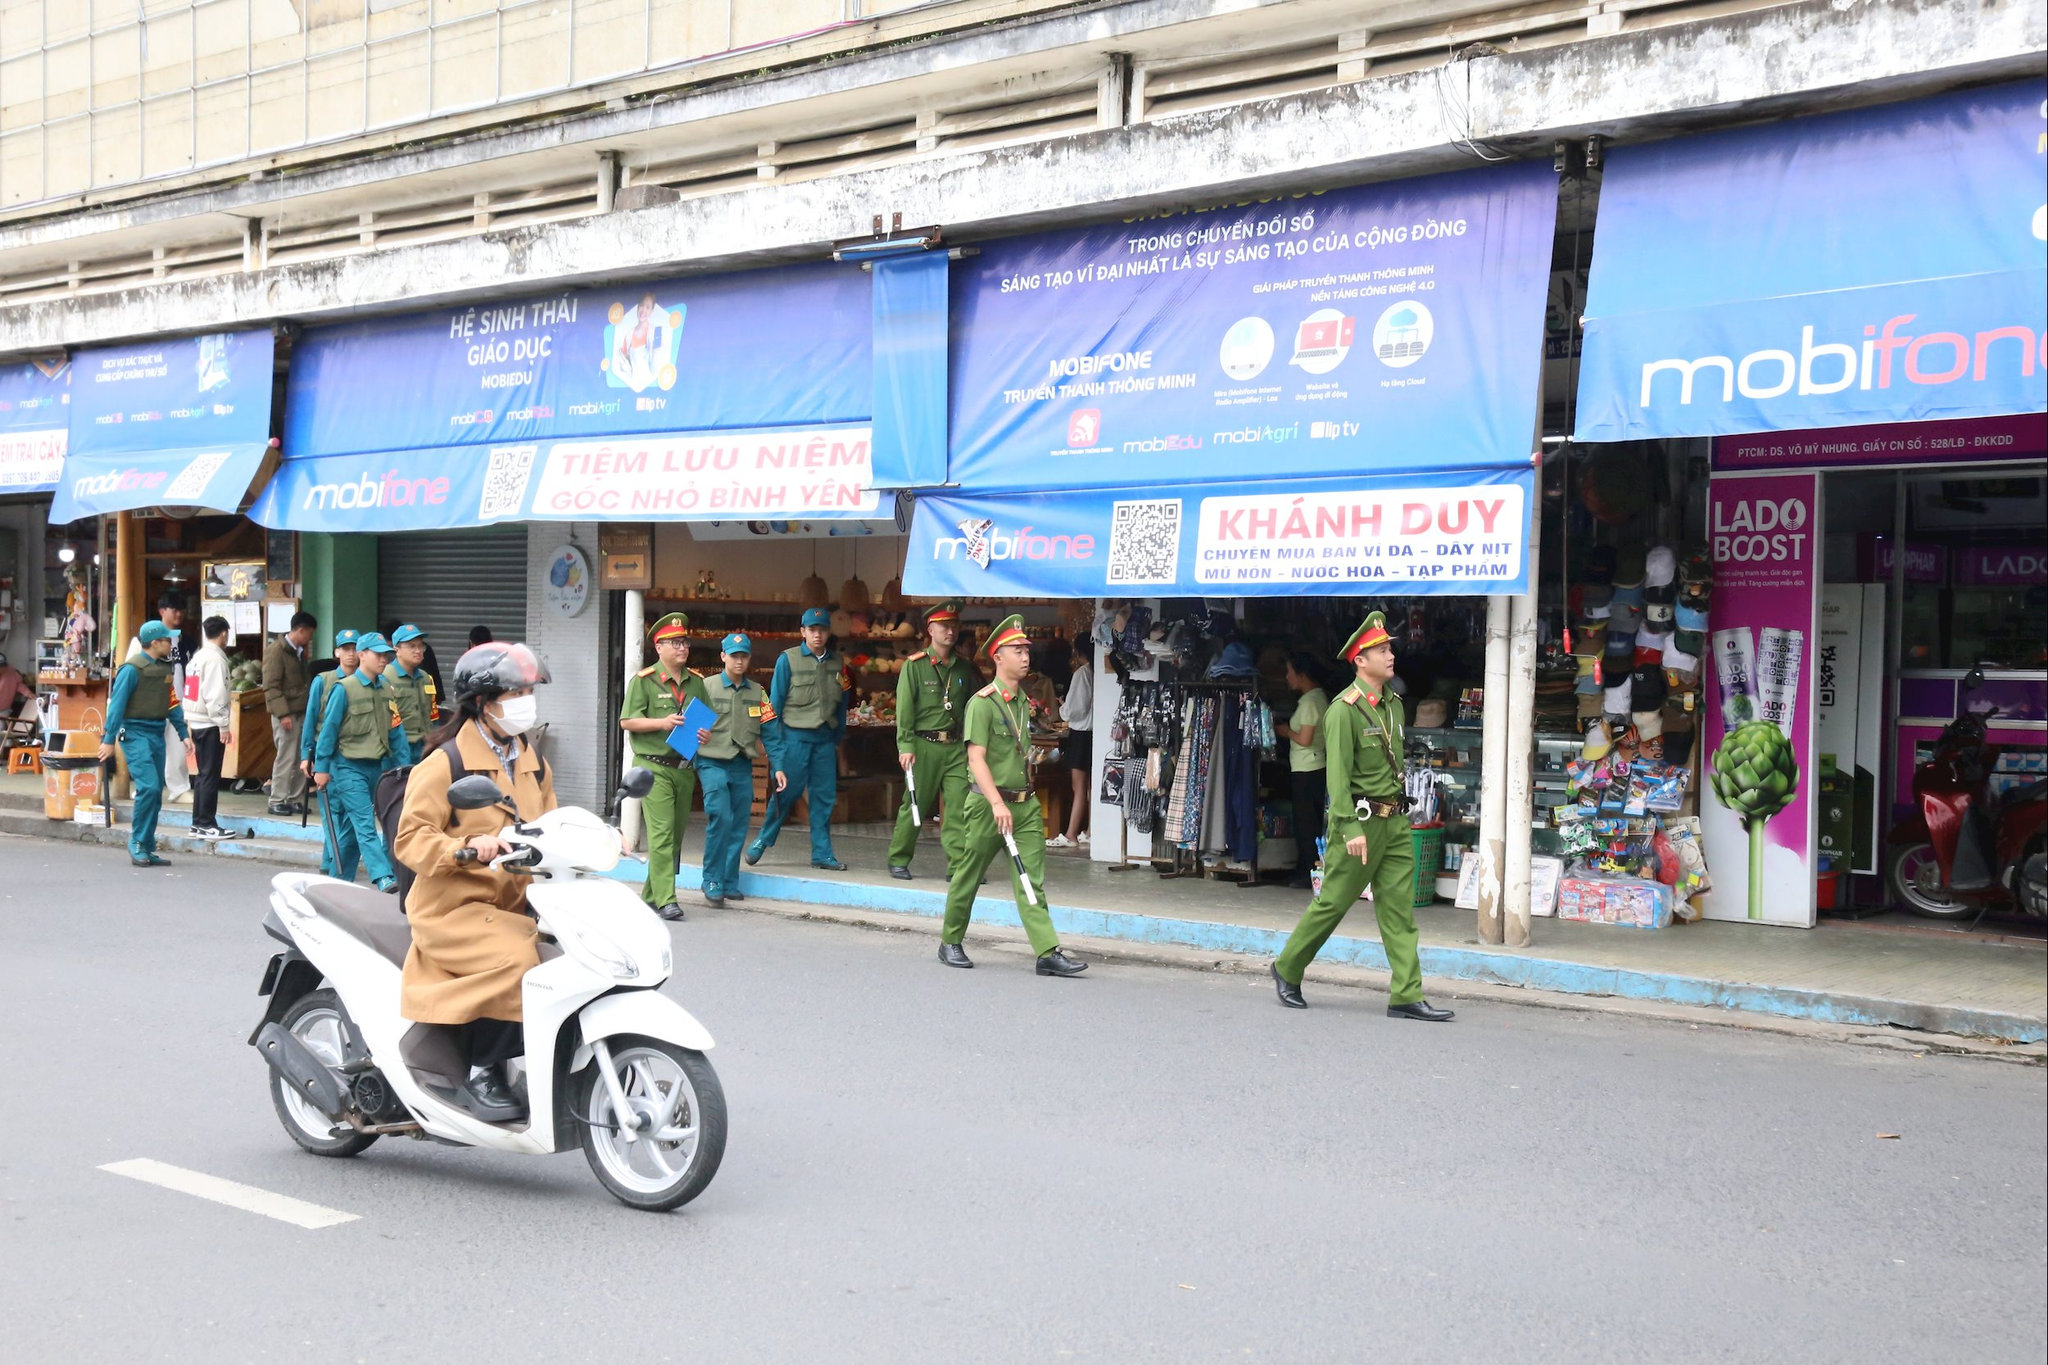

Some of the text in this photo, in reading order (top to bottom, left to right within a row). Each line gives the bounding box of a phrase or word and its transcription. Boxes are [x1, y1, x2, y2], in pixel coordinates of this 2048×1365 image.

[1128, 209, 1316, 255] TRONG CHUYỂN ĐỔI SỐ
[1001, 217, 1467, 293] SÁNG TẠO VĨ ĐẠI NHẤT LÀ SỰ SÁNG TẠO CỦA CỘNG ĐỒNG
[1338, 271, 1371, 285] THANH
[1372, 267, 1407, 281] THÔNG
[1407, 264, 1435, 278] MINH
[1359, 283, 1387, 297] CÔNG
[1417, 280, 1435, 291] 4.0
[450, 294, 577, 344] HỆ SINH THÁI
[467, 336, 552, 366] GIÁO DỤC
[1050, 350, 1153, 378] MOBIFONE
[1640, 313, 2047, 408] mobifon
[481, 371, 532, 389] MOBIEDU
[1003, 372, 1196, 405] TRUYỀN THANH THÔNG MINH
[1123, 434, 1203, 454] mobiEdu
[1213, 421, 1299, 445] mobiAgri
[1738, 447, 1767, 457] PTCM:
[1821, 442, 1860, 454] NHUNG.
[1862, 437, 1886, 452] GIẤY
[1889, 440, 1904, 451] CN
[1907, 436, 1922, 450] SỐ
[562, 436, 868, 481] TIỆM LƯU NIỆM
[73, 468, 168, 500] mobifone
[303, 469, 449, 510] mobifone
[550, 478, 862, 510] GÓC NHỎ BÌNH YÊN
[1218, 496, 1505, 541] KHÁNH DUY
[1714, 498, 1807, 533] LADO
[1204, 545, 1271, 561] CHUYÊN
[1277, 547, 1316, 560] MUA
[1363, 543, 1381, 557] VÍ
[1388, 544, 1413, 557] DA
[1436, 541, 1474, 556] DÂY
[1482, 542, 1513, 558] NỊT
[1714, 534, 1806, 563] BOOST
[1883, 548, 1936, 571] LAOPHAR
[1237, 564, 1272, 579] NÓN
[1291, 563, 1340, 578] NƯỚC
[1347, 564, 1385, 578] HOA
[1407, 564, 1444, 580] TẠP
[1451, 558, 1508, 576] PHẨM
